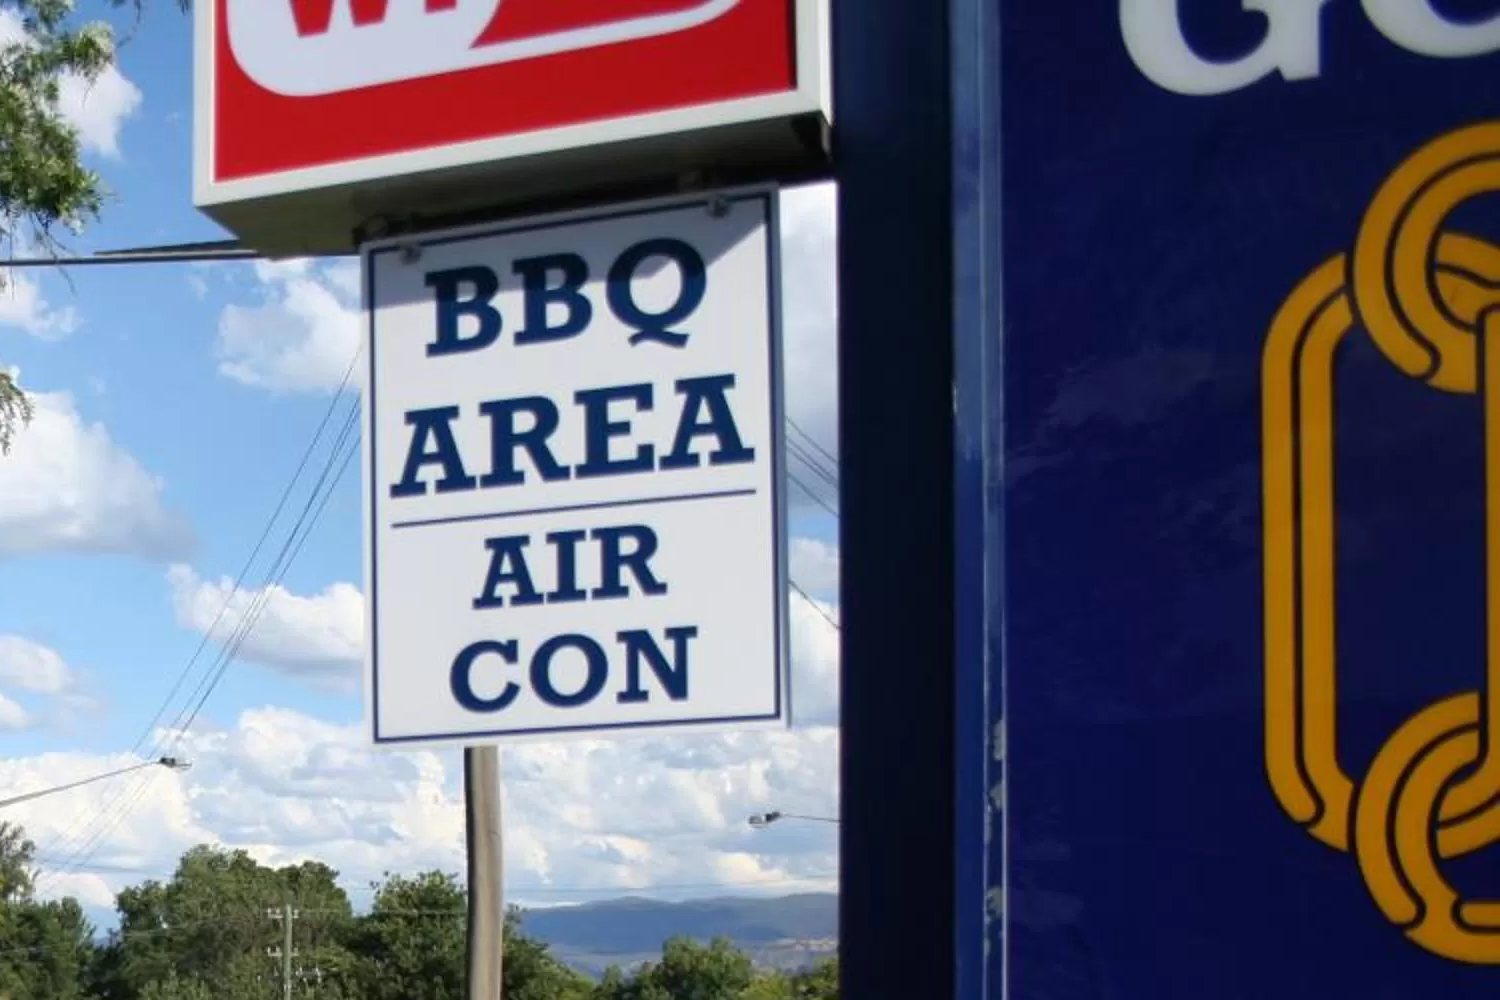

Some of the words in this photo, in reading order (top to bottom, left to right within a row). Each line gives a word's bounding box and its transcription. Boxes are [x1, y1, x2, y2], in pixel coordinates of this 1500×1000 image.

[424, 237, 707, 358] BBQ
[389, 373, 755, 499] AREA
[472, 524, 667, 609] AIR
[450, 625, 698, 713] CON
